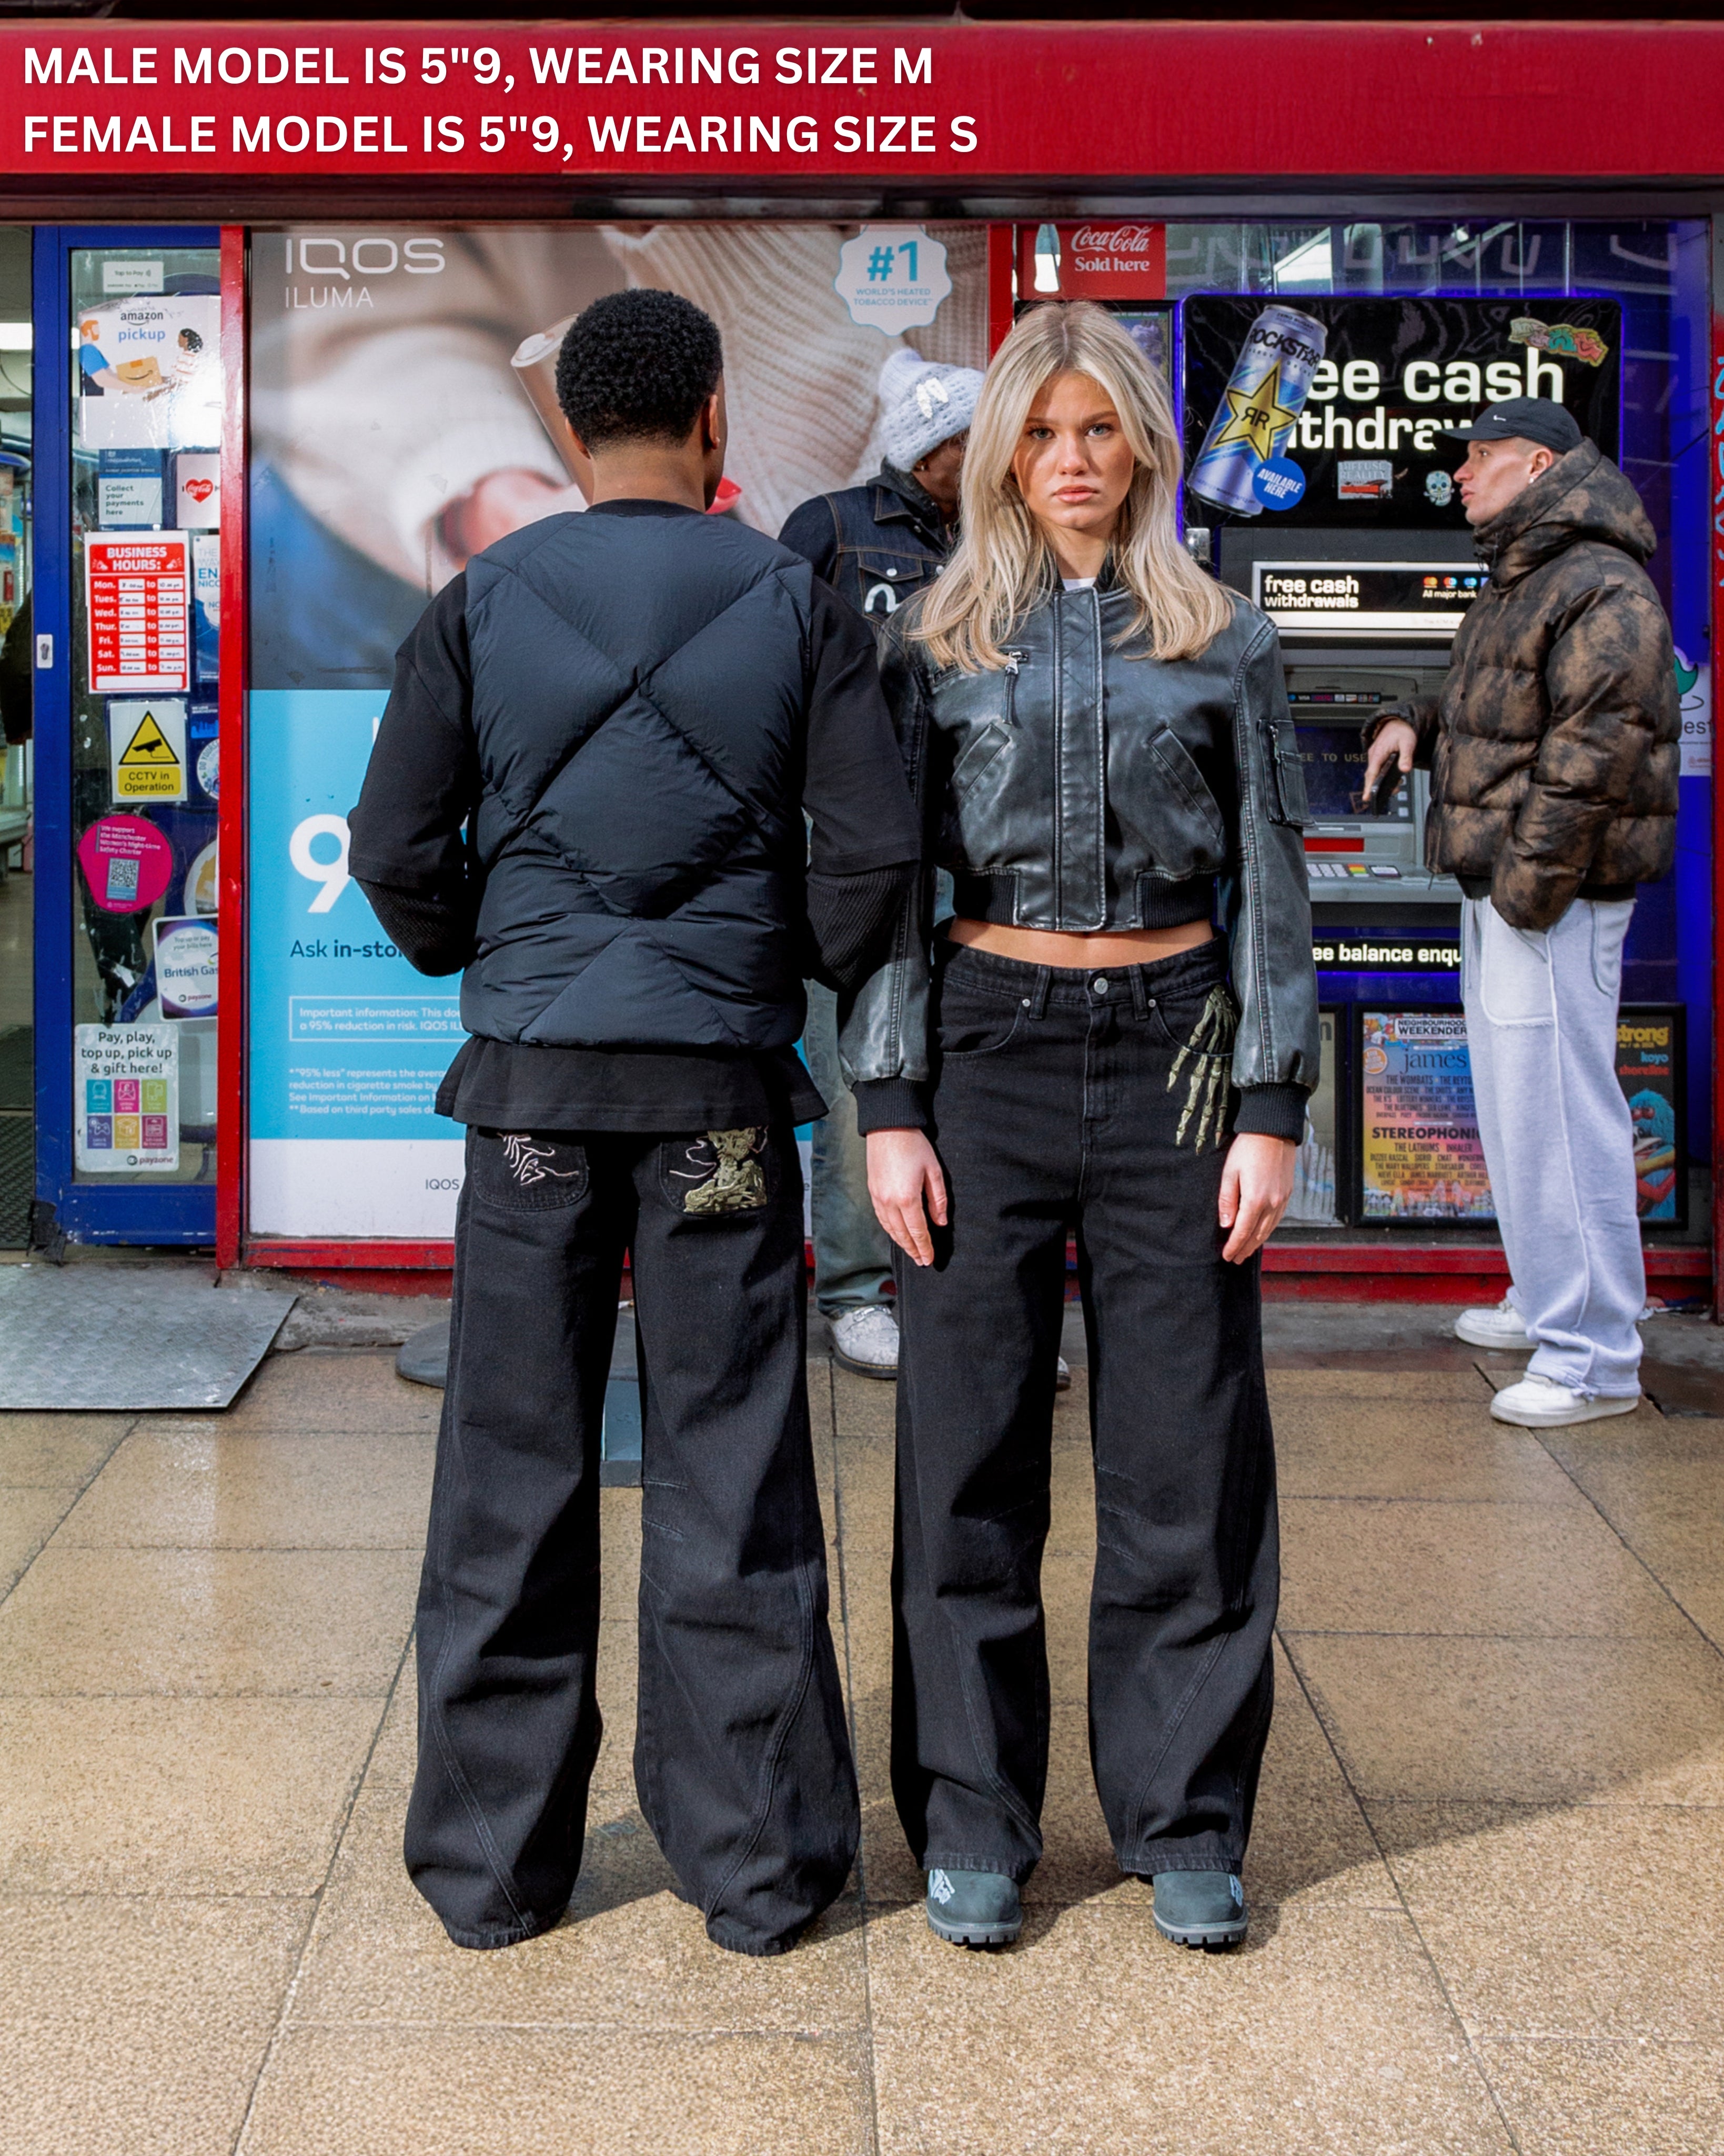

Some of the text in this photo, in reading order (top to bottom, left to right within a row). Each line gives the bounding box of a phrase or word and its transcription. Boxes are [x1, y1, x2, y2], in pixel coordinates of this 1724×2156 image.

[1071, 225, 1154, 252] Coca-Cola
[286, 238, 445, 280] IQOS
[867, 240, 918, 281] #1
[1075, 257, 1150, 272] Sold here
[285, 287, 374, 308] ILUMA
[120, 312, 164, 320] amazon
[118, 328, 166, 343] pickup
[1404, 347, 1564, 404] cash
[1257, 468, 1303, 494] AVAILABLE
[1263, 480, 1289, 498] HERE
[107, 547, 167, 558] BUSINESS
[113, 559, 161, 570] HOURS:
[1265, 575, 1359, 593] free cash
[1265, 593, 1359, 608] withdrawals
[1423, 589, 1433, 598] All
[1434, 589, 1457, 600] major
[98, 636, 113, 645] Fri.
[97, 664, 116, 673] Sun.
[1322, 753, 1338, 762] TO
[1344, 754, 1367, 762] USE
[128, 771, 169, 780] CCTV in
[124, 783, 174, 793] Operation
[112, 833, 146, 841] Manchester
[100, 846, 118, 855] Safety
[290, 940, 328, 958] Ask
[1339, 943, 1413, 962] balance
[165, 967, 198, 978] British
[300, 1007, 353, 1019] Important
[355, 1007, 418, 1017] information:
[421, 1007, 442, 1017] This
[309, 1020, 332, 1030] 95%
[335, 1020, 385, 1030] reduction
[387, 1020, 397, 1030] in
[398, 1020, 418, 1030] risk.
[420, 1020, 448, 1031] IQOS
[98, 1031, 155, 1044] Pay, play,
[82, 1048, 103, 1059] top
[128, 1047, 153, 1059] pick
[1399, 1048, 1467, 1074] james
[91, 1062, 163, 1075] & gift here!
[347, 1069, 397, 1079] represents
[399, 1068, 415, 1077] the
[289, 1080, 438, 1092] reduction in cigarette smoke by
[1386, 1075, 1398, 1085] THE
[289, 1092, 307, 1101] See
[309, 1092, 357, 1104] Important
[360, 1092, 416, 1101] Information
[345, 1105, 368, 1114] third
[370, 1106, 396, 1116] party
[399, 1105, 422, 1114] sales
[139, 1157, 174, 1165] payzone
[426, 1178, 460, 1191] IQOS
